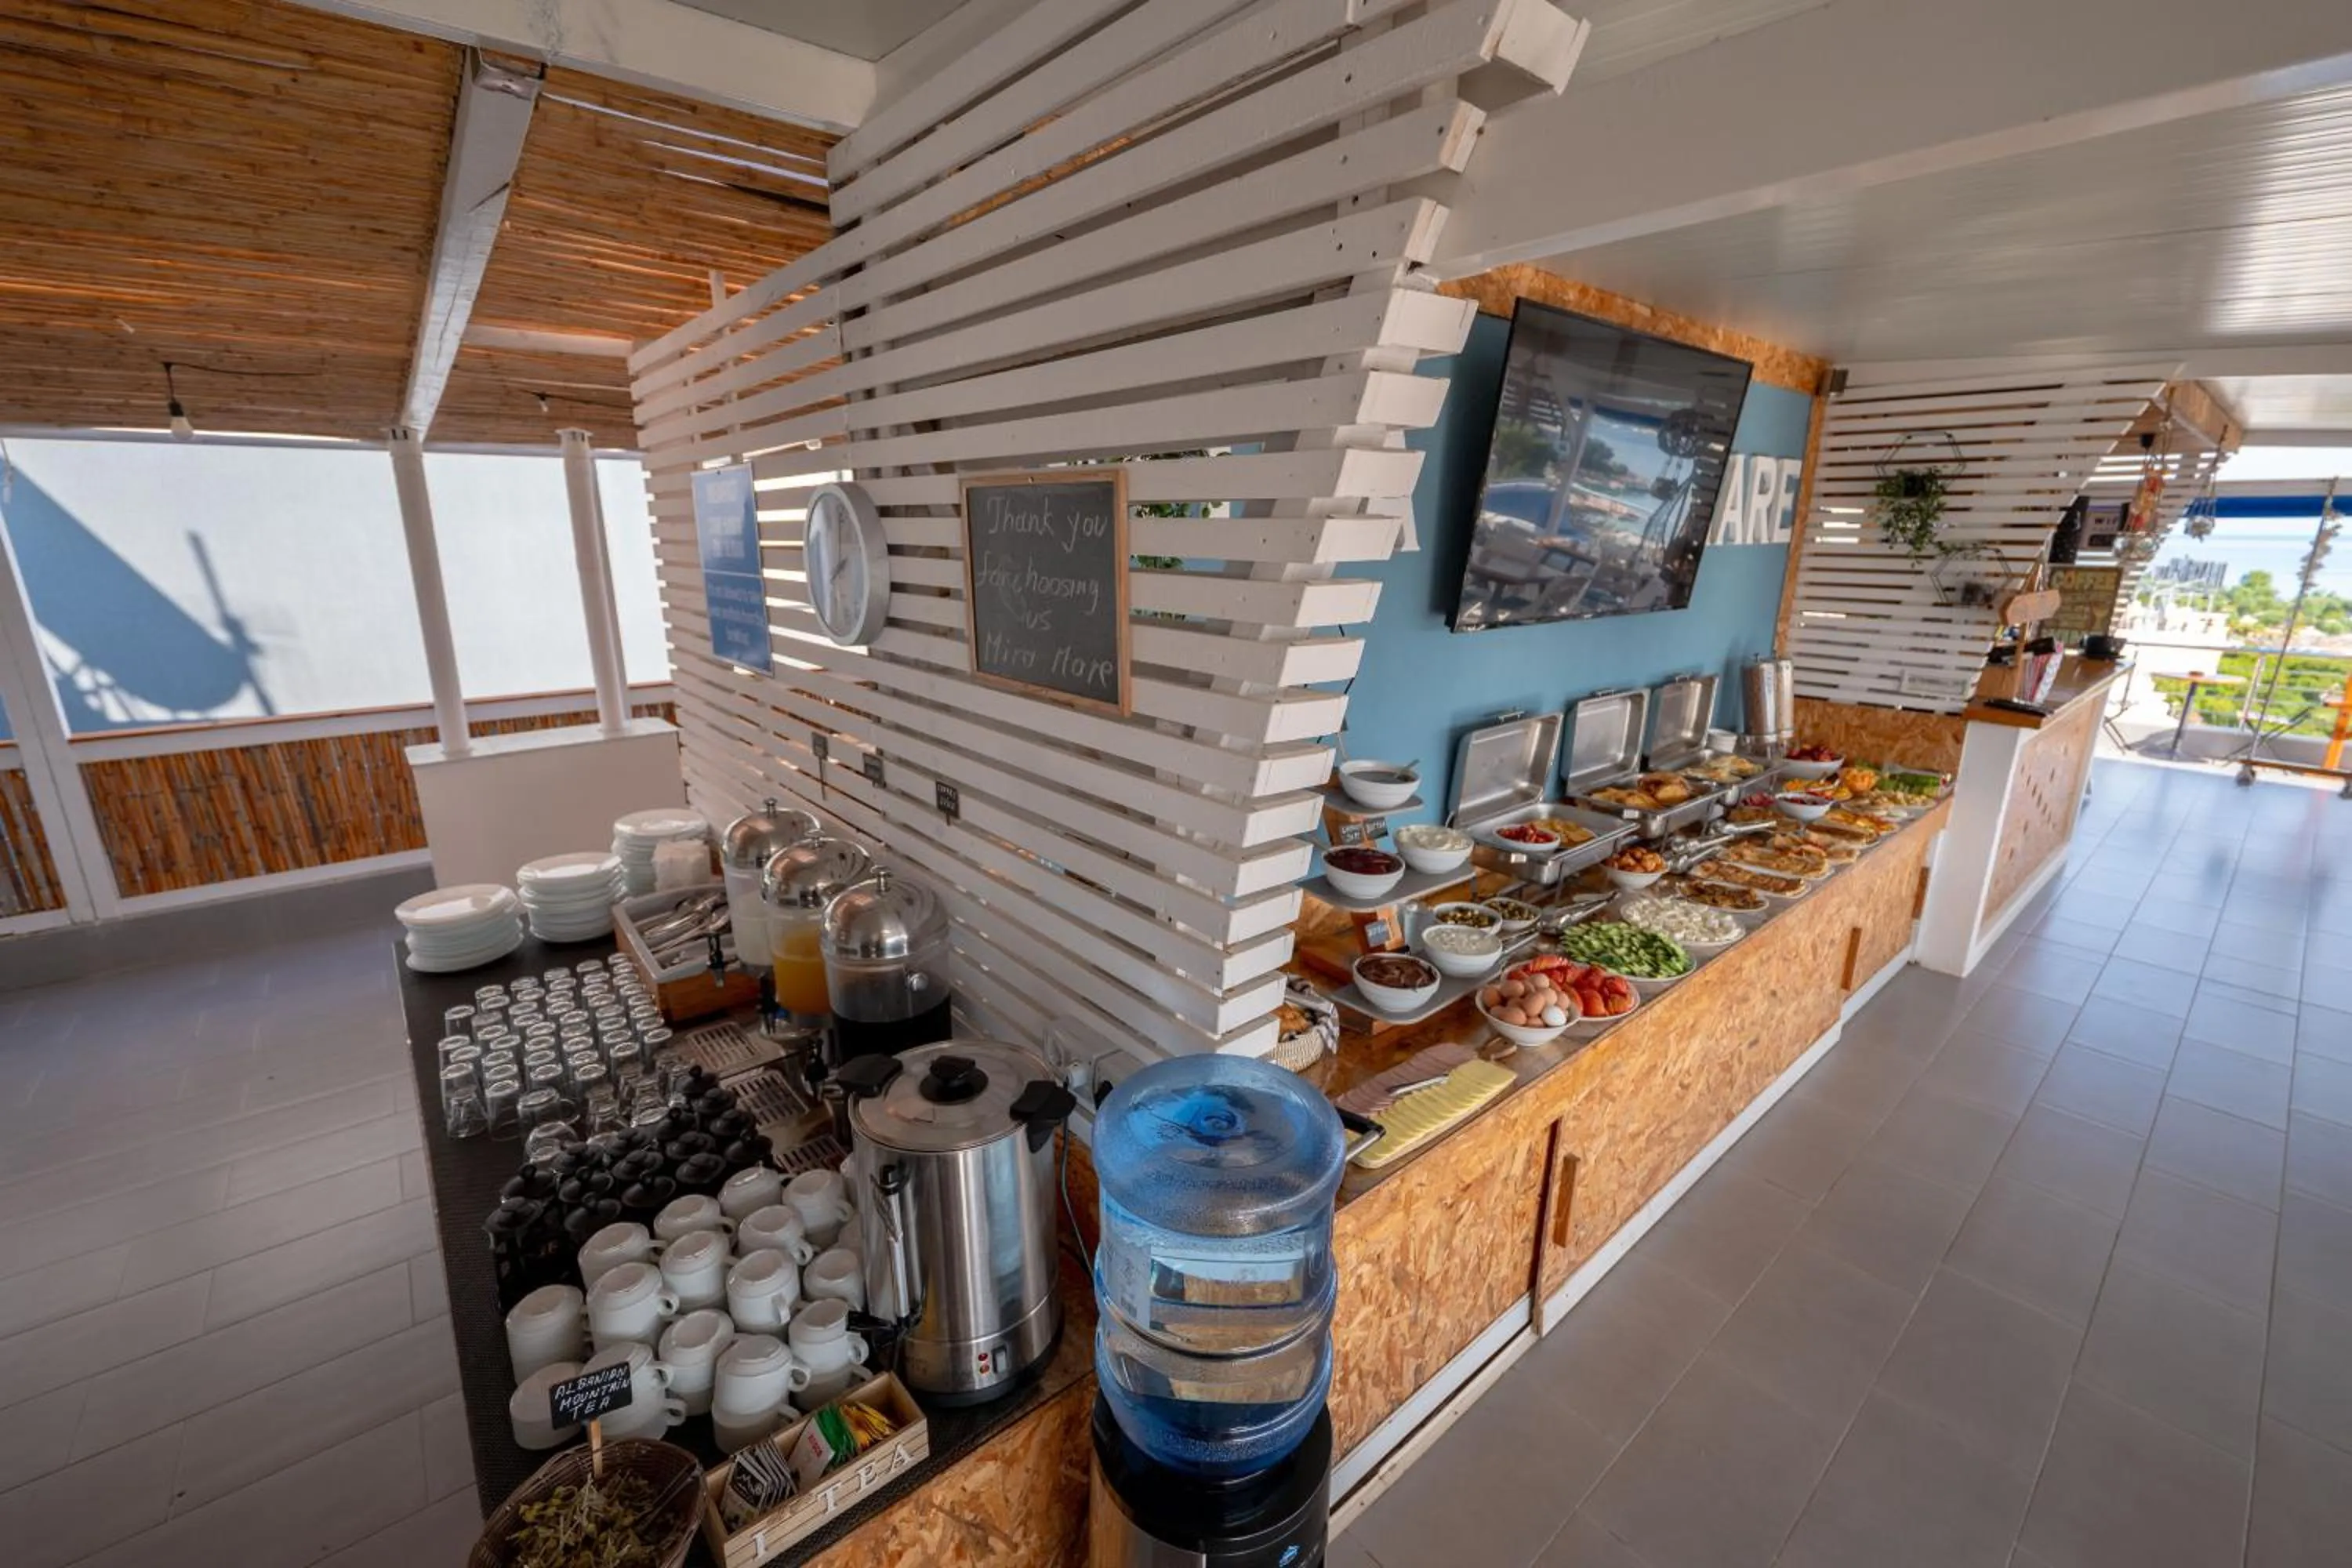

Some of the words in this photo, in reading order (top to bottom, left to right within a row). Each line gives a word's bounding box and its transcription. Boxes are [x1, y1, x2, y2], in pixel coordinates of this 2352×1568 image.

[986, 495, 1055, 537] Thank
[1061, 510, 1109, 554] you
[1011, 554, 1100, 616] choosing
[1025, 608, 1053, 632] us
[554, 1366, 628, 1400] ALBANIAN
[559, 1377, 630, 1412] MOUNTAIN
[570, 1396, 611, 1421] TEA
[816, 1441, 914, 1515] TEA
